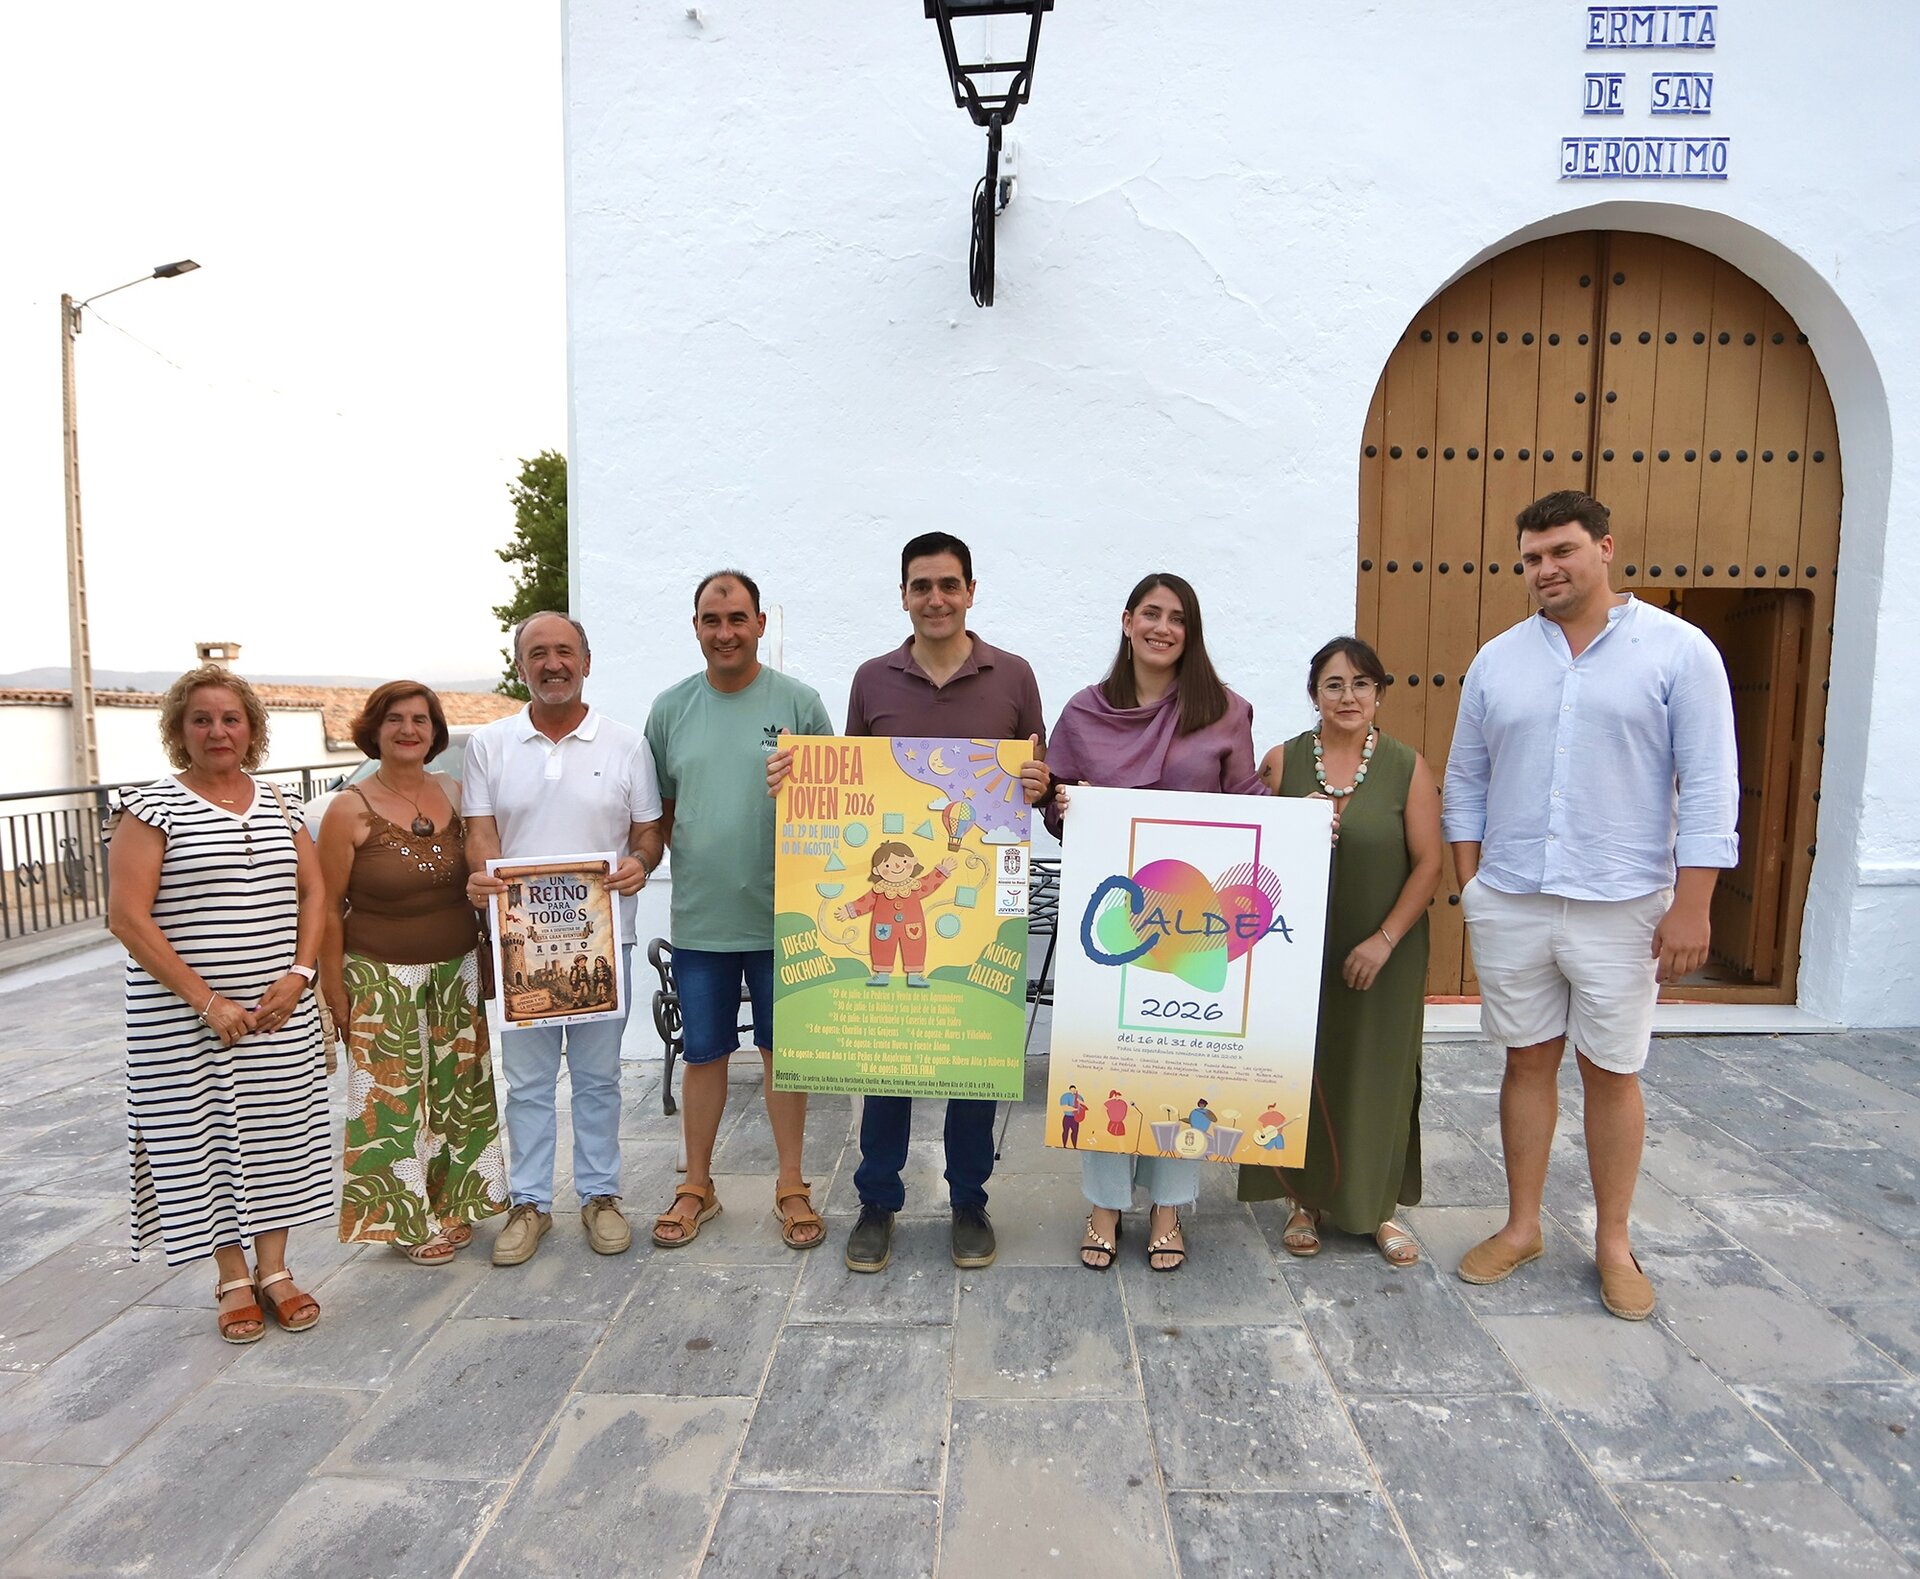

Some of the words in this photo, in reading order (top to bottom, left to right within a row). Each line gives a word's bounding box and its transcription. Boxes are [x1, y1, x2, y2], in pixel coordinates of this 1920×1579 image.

[1588, 12, 1716, 43] ERMITA
[1585, 78, 1623, 109] DE
[1652, 78, 1714, 109] SAN
[1564, 142, 1728, 174] JERONIMO
[786, 745, 864, 785] CALDEA
[785, 786, 839, 823] JOVEN
[844, 793, 875, 816] 2026
[782, 824, 795, 838] DEL
[797, 824, 807, 838] 29
[808, 824, 819, 839] DE
[820, 824, 840, 840] JULIO
[781, 841, 791, 855] 10
[791, 841, 801, 855] DE
[803, 841, 832, 856] AGOSTO
[549, 876, 565, 886] UN
[528, 884, 588, 905] REINO
[528, 908, 587, 925] TOD@S
[547, 902, 571, 910] PARA
[1080, 875, 1294, 967] CALDEA
[781, 929, 820, 960] JUEGOS
[983, 942, 1022, 971] MÚSICA
[780, 955, 836, 985] COLCHONES
[966, 962, 1016, 995] TALLERES
[1140, 999, 1224, 1021] 2026
[788, 1048, 795, 1058] de
[795, 1049, 814, 1060] agosto:
[1117, 1033, 1135, 1043] del
[1137, 1036, 1154, 1044] 16
[1156, 1037, 1169, 1046] al
[1171, 1038, 1186, 1047] 31
[1190, 1038, 1203, 1049] de
[1206, 1041, 1244, 1053] agosto
[775, 1070, 801, 1082] Horarios:
[869, 1062, 877, 1073] de
[878, 1063, 899, 1075] agosto:
[900, 1064, 919, 1075] FIESTA
